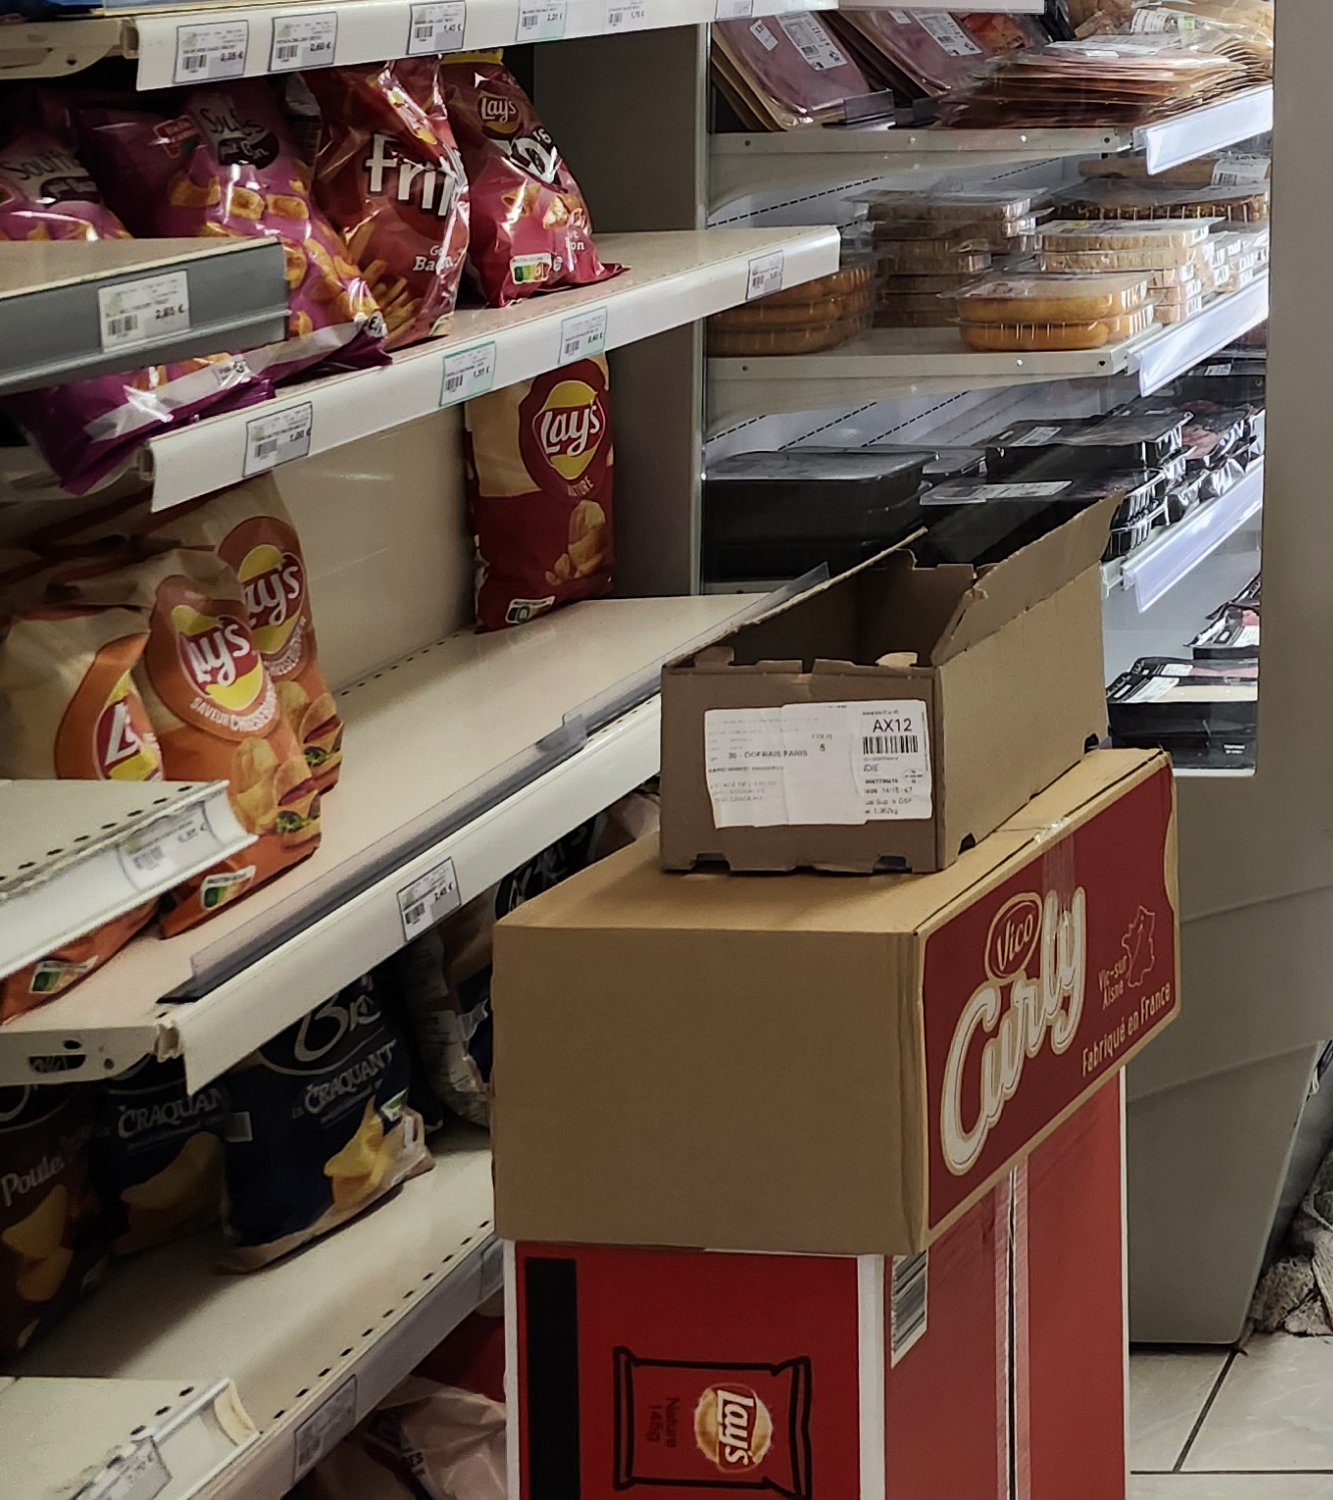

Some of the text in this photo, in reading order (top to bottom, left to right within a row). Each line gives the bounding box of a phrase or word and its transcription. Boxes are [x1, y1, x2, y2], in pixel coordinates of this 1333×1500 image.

[480, 95, 518, 123] Lay's
[540, 402, 601, 457] Lay's
[872, 717, 913, 733] AX12
[996, 912, 1035, 972] Vico
[1098, 953, 1128, 992] Vic-sur
[1102, 978, 1125, 1010] Aisne
[940, 887, 1087, 1177] Curly
[1082, 981, 1172, 1078] Fabriqué en France
[304, 1038, 397, 1114] CRAQUANT
[715, 1388, 755, 1469] Lay's
